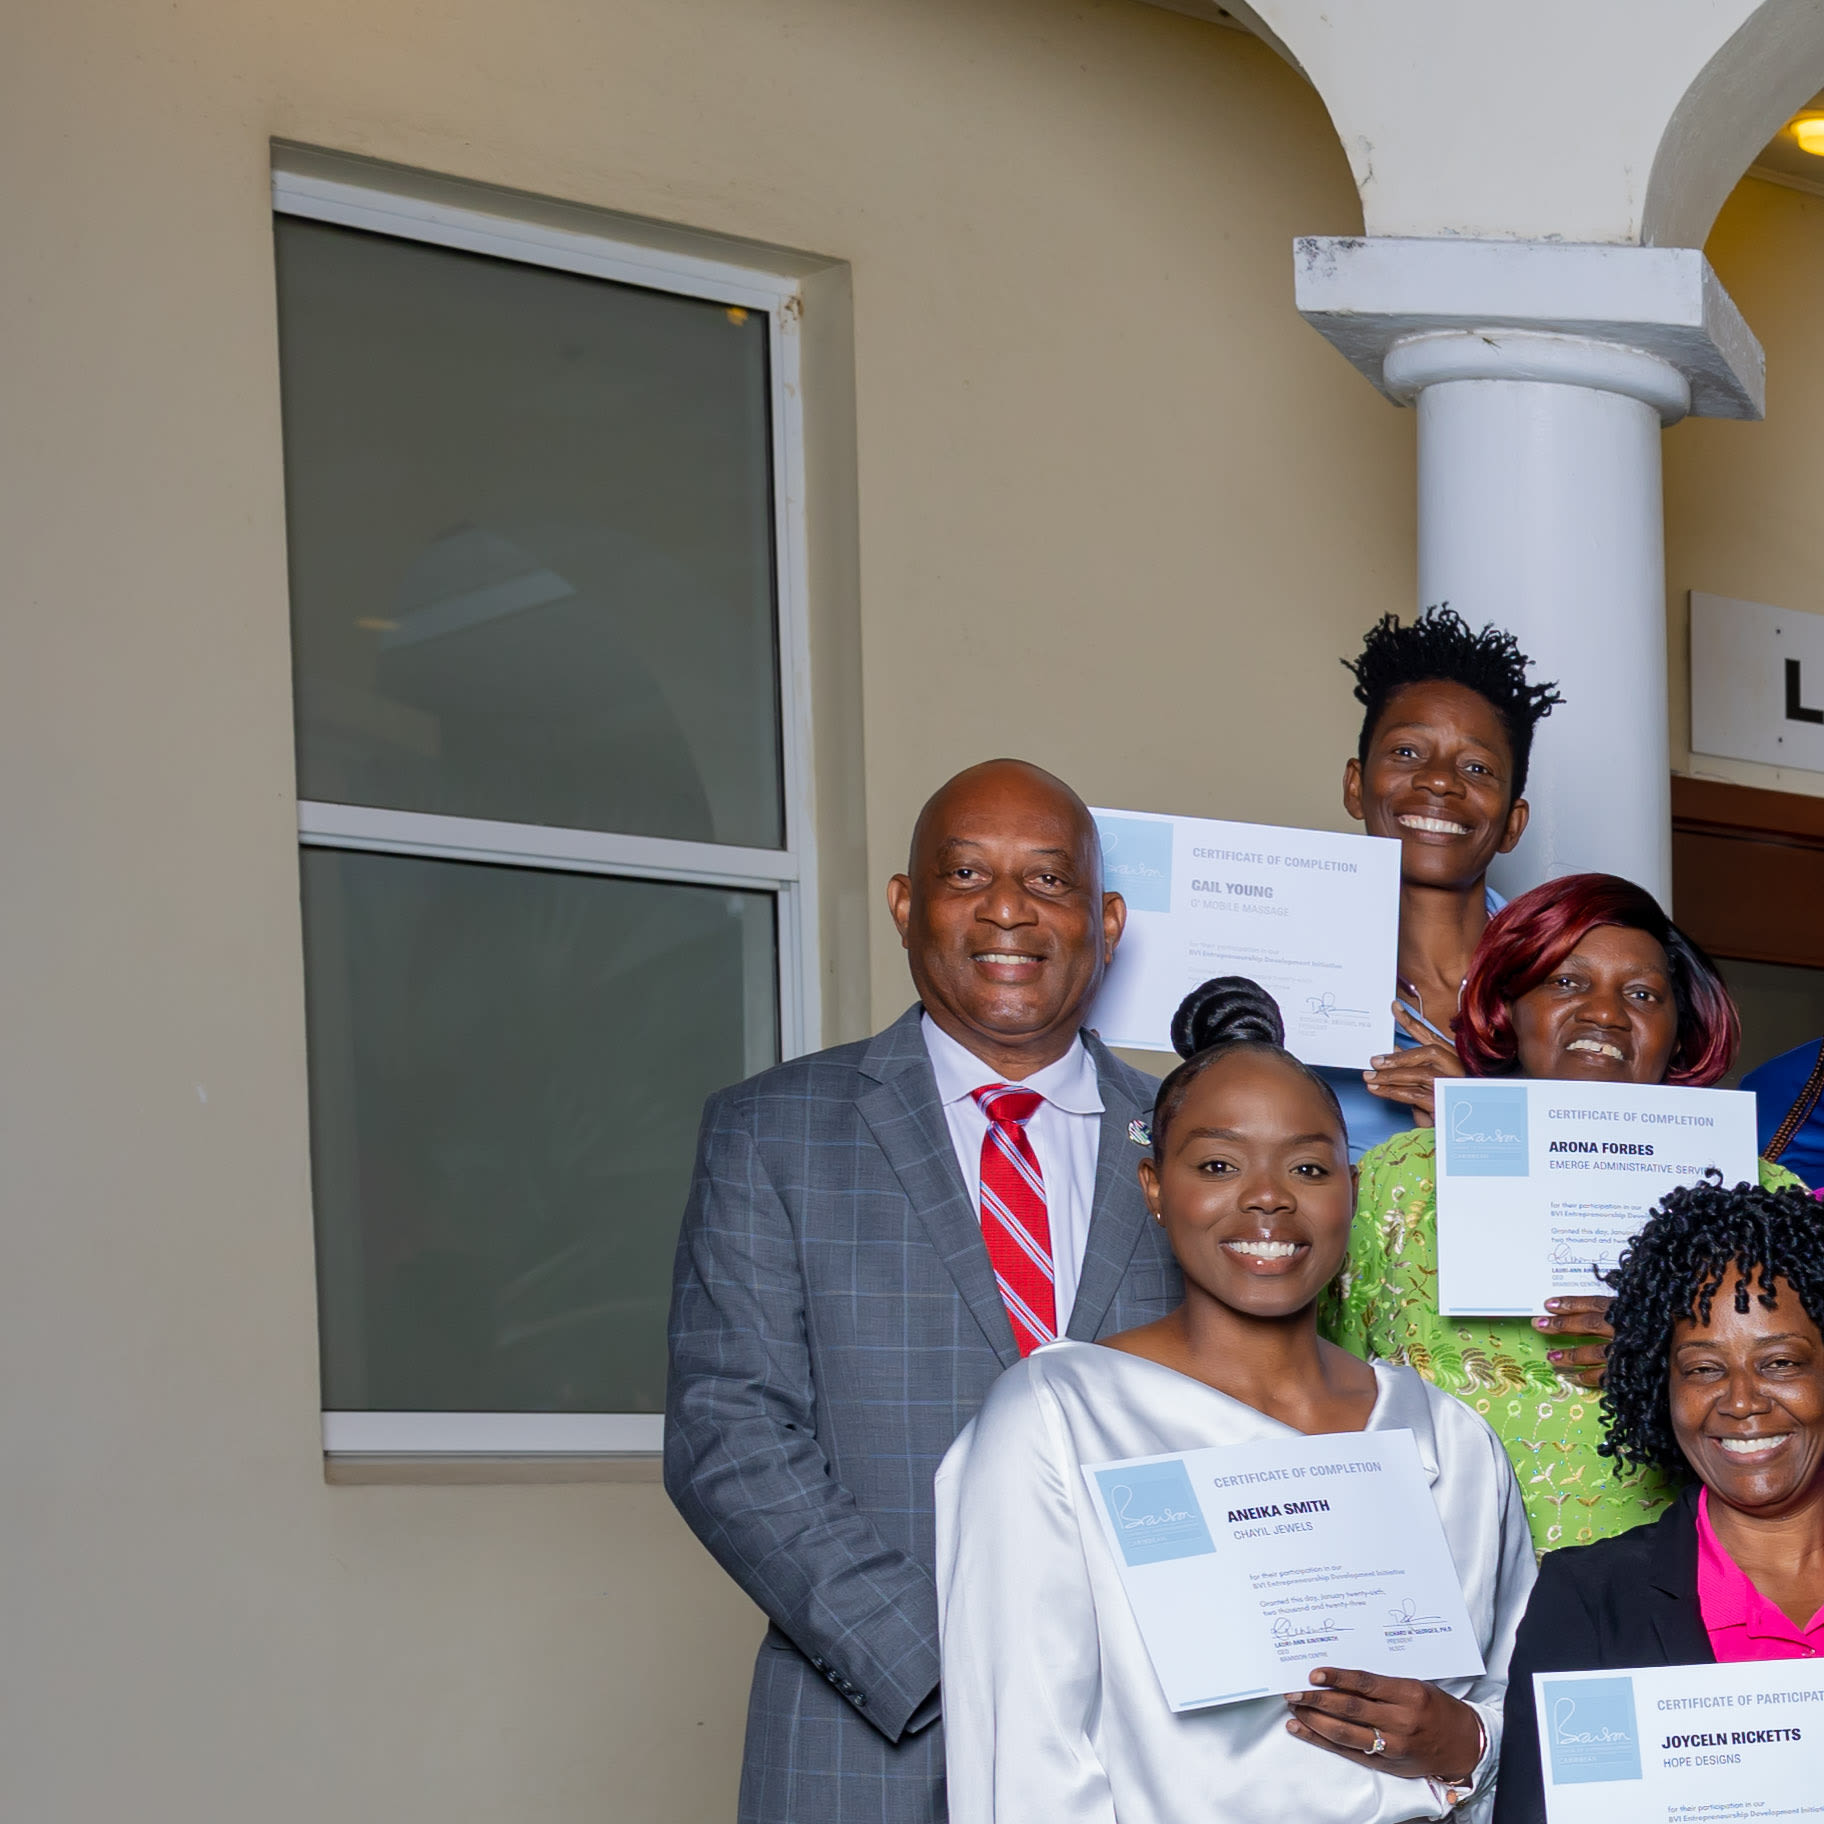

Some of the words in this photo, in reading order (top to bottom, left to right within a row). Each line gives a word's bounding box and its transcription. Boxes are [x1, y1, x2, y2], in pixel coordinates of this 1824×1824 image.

[1193, 847, 1263, 863] CERTIFICATE
[1267, 855, 1281, 865] OF
[1285, 857, 1357, 873] COMPLETION
[1192, 879, 1221, 893] GAIL
[1226, 882, 1273, 898] YOUNG
[1549, 1109, 1619, 1122] CERTIFICATE
[1624, 1112, 1638, 1123] OF
[1641, 1113, 1714, 1127] COMPLETION
[1549, 1141, 1598, 1154] ARONA
[1602, 1143, 1654, 1156] FORBES
[1550, 1161, 1590, 1171] EMERGE
[1593, 1162, 1673, 1174] ADMINISTRATIVE
[1675, 1165, 1707, 1175] SERVI
[1214, 1471, 1290, 1488] CERTIFICATE
[1294, 1469, 1306, 1481] OF
[1310, 1462, 1382, 1479] COMPLETION
[1227, 1505, 1282, 1523] ANEIKA
[1284, 1499, 1330, 1517] SMITH
[1234, 1526, 1270, 1541] CHAYIL
[1273, 1521, 1313, 1536] JEWELS
[1658, 1696, 1734, 1711] CERTIFICATE
[1738, 1694, 1753, 1707] OF
[1662, 1732, 1728, 1750] JOYCELN
[1732, 1728, 1801, 1745] RICKETTS
[1664, 1757, 1692, 1768] HOPE
[1695, 1754, 1741, 1766] DESIGNS
